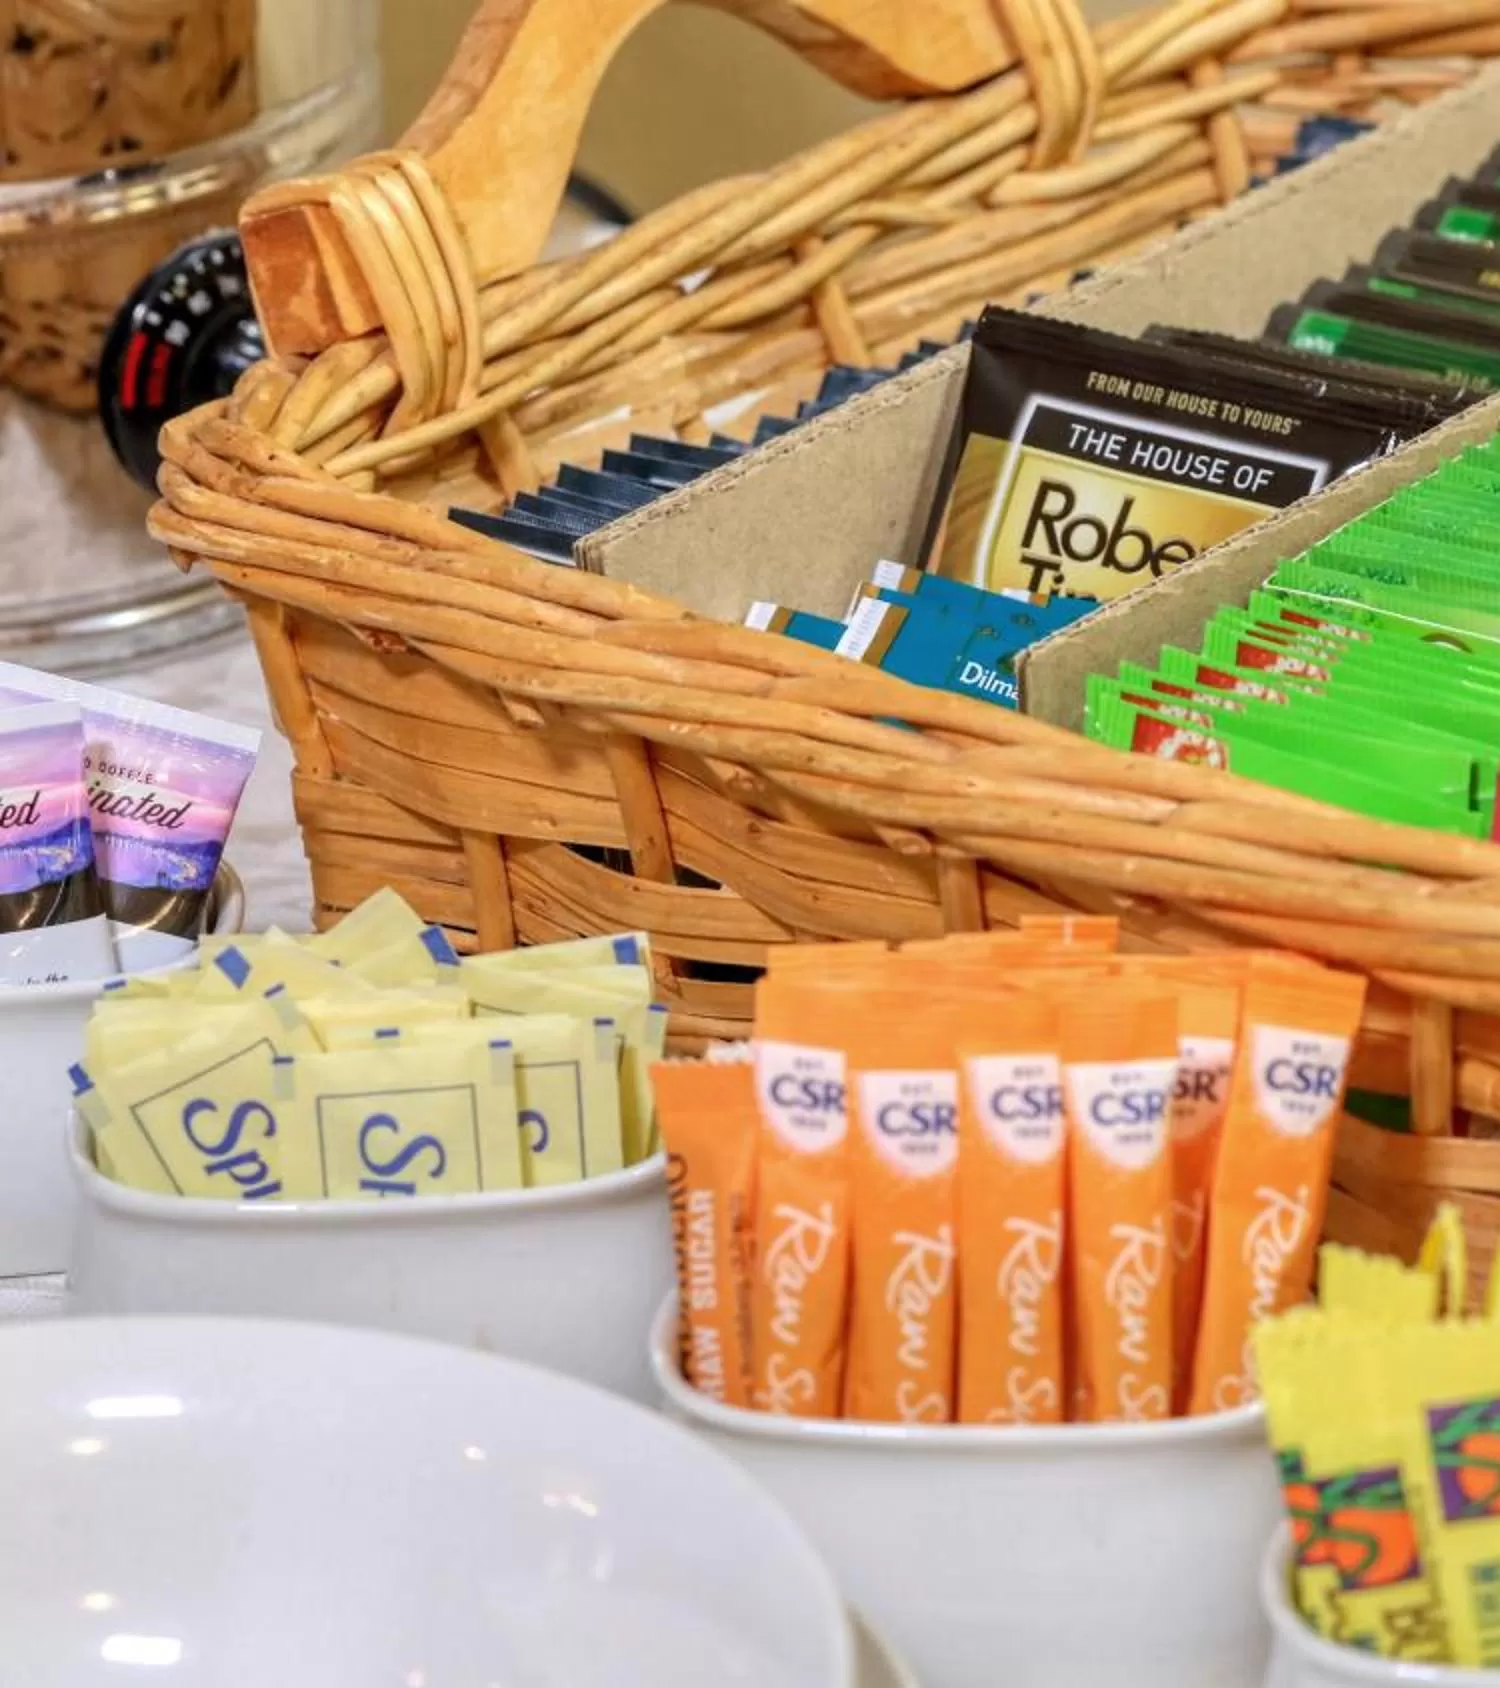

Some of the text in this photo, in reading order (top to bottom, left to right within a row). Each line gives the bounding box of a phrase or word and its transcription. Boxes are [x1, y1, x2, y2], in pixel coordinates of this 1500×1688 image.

[1087, 371, 1131, 398] FROM
[1132, 383, 1165, 404] OUR
[1166, 389, 1219, 418] HOUSE
[1220, 401, 1241, 424] TO
[1068, 423, 1275, 493] THE HOUSE OF
[1020, 476, 1203, 578] Robe
[0, 791, 41, 829] ed
[87, 780, 192, 829] inated
[770, 1073, 848, 1113] CSR
[991, 1084, 1067, 1120] CSR
[1171, 1066, 1218, 1103] SR
[1265, 1057, 1337, 1099] CSR
[878, 1102, 960, 1136] CSR
[1091, 1088, 1167, 1125] CSR
[689, 1189, 718, 1310] SUGAR
[764, 1201, 836, 1344] Raw
[885, 1221, 956, 1370] Raw
[997, 1208, 1063, 1356] Raw
[1105, 1214, 1166, 1362] Raw
